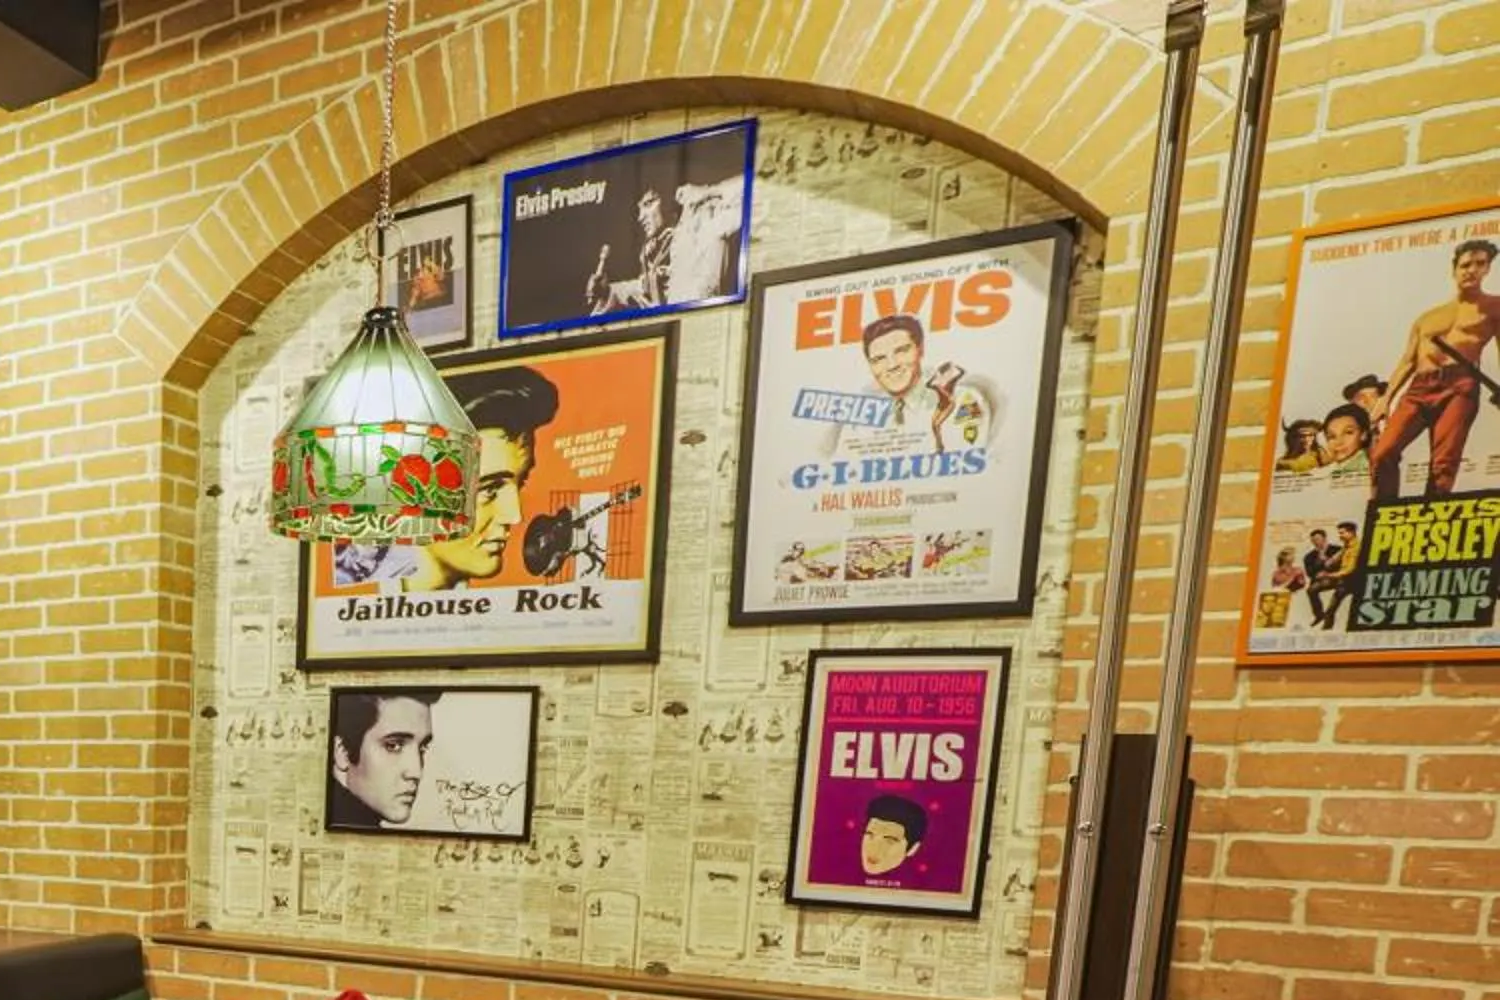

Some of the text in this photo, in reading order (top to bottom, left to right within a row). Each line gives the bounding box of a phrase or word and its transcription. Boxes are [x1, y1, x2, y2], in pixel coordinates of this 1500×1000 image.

[515, 180, 607, 221] Elvis Presley
[796, 269, 1013, 351] ELVIS
[798, 391, 891, 427] PRESLEY
[850, 487, 904, 511] WALLIS
[1375, 497, 1500, 525] ELVIS
[1366, 515, 1500, 567] PRESLEY
[1363, 566, 1492, 599] FLAMING
[338, 586, 603, 622] Jailhouse Rock
[831, 674, 982, 694] MOON AUDITORIUM
[906, 696, 923, 714] 10
[830, 731, 965, 781] ELVIS
